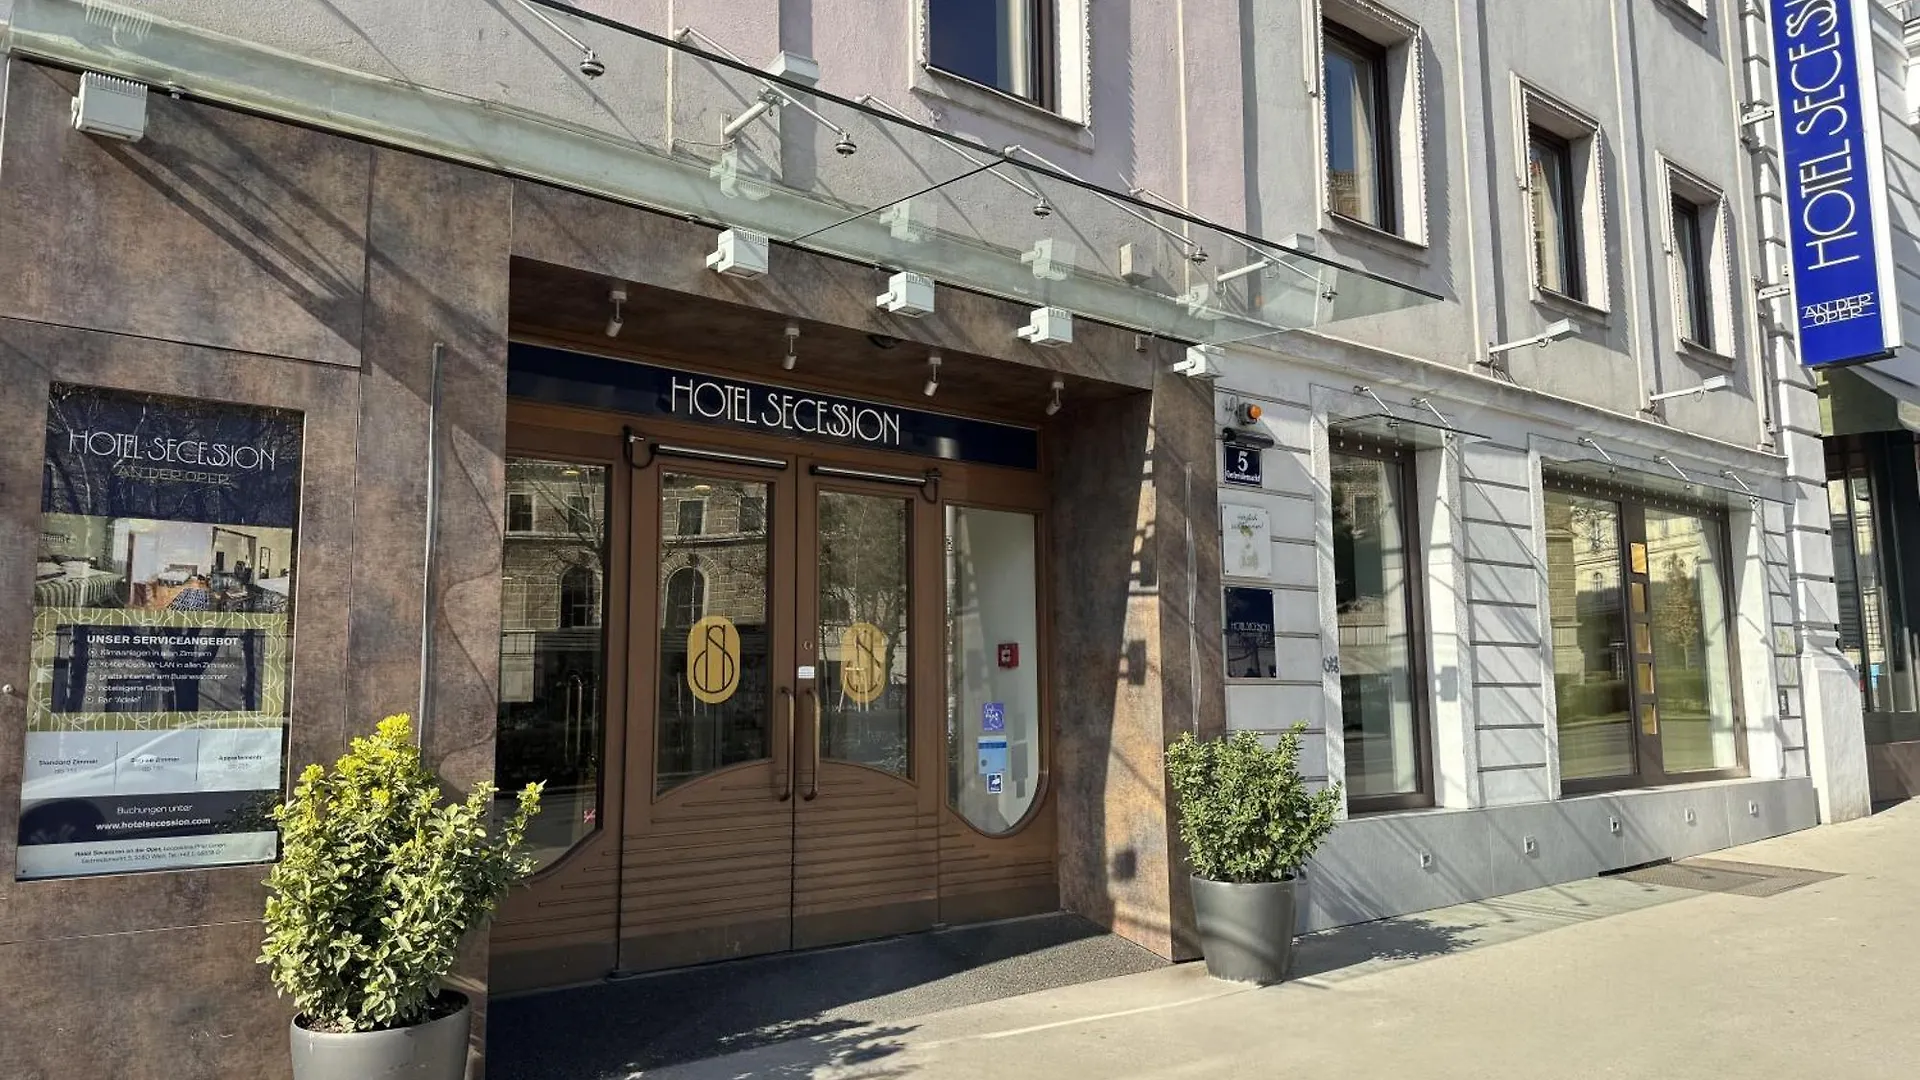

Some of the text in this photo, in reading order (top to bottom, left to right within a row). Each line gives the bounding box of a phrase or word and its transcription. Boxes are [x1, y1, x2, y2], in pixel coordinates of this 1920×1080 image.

[1799, 139, 1860, 271] HOTEL
[1804, 294, 1871, 319] AN DER
[1814, 306, 1863, 324] OPER
[672, 376, 900, 445] HOTEL SECESSION
[69, 429, 275, 470] HOTEL SECESSION
[1237, 451, 1249, 472] 5
[185, 471, 231, 485] OPER
[87, 635, 239, 646] UNSER SERVICEANGEBOT
[117, 803, 193, 815] Buchungen unter
[96, 816, 211, 831] www.hotelsecession.com
